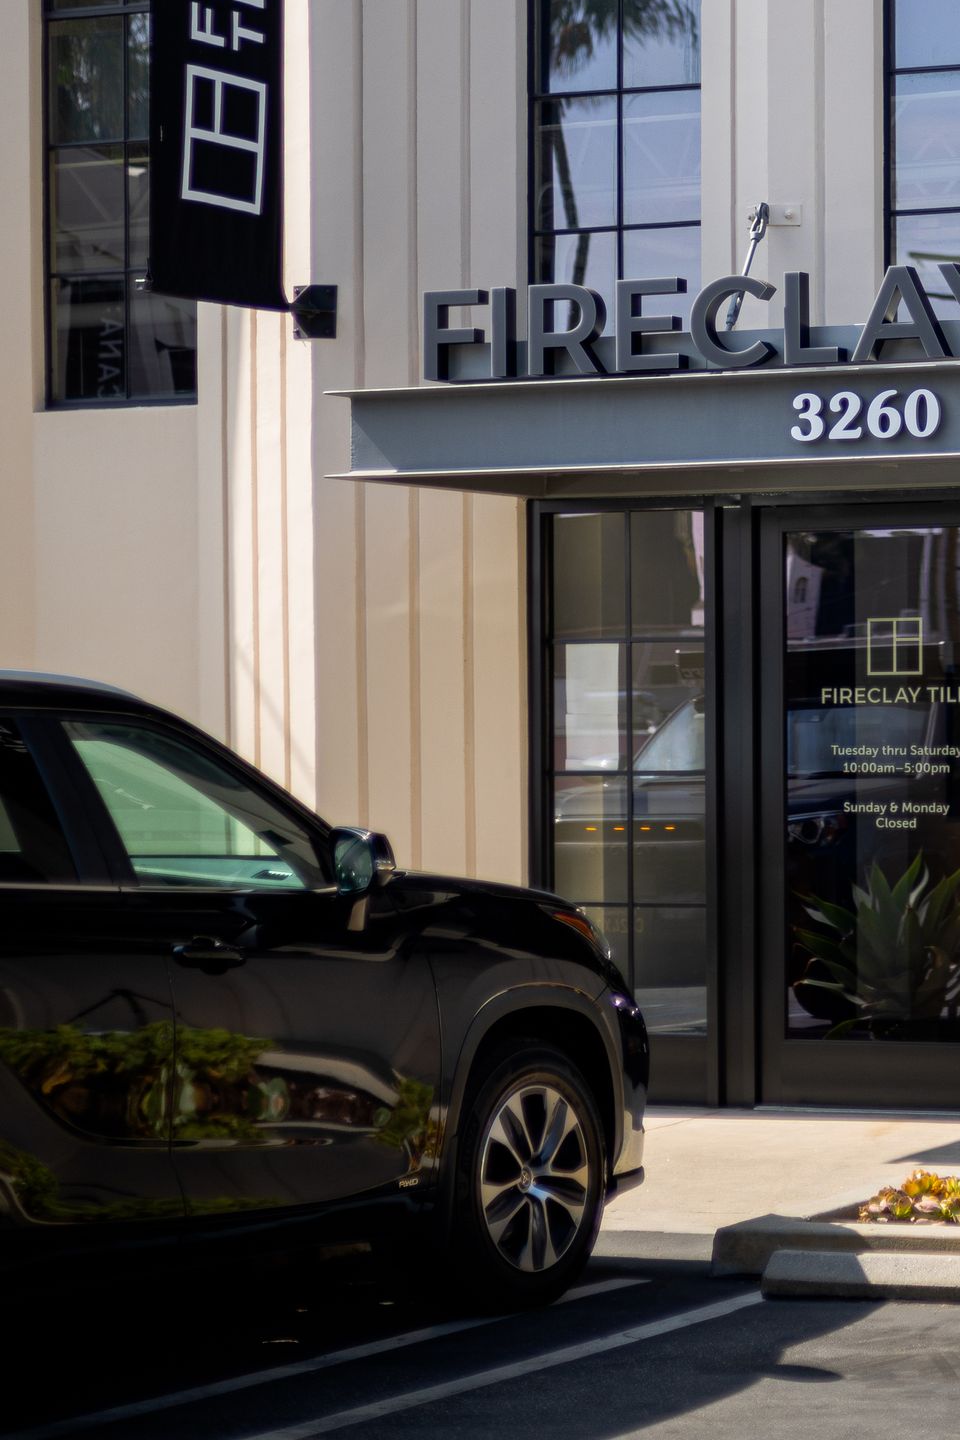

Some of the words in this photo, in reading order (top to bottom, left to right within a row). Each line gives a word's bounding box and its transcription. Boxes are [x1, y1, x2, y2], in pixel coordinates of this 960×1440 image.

[789, 388, 943, 443] 3260
[821, 686, 921, 705] FIRECLAY
[831, 744, 879, 759] Tuesday
[882, 744, 907, 756] thru
[843, 801, 887, 816] Sunday
[890, 802, 899, 813] &
[902, 802, 951, 816] Monday
[875, 817, 917, 829] Closed
